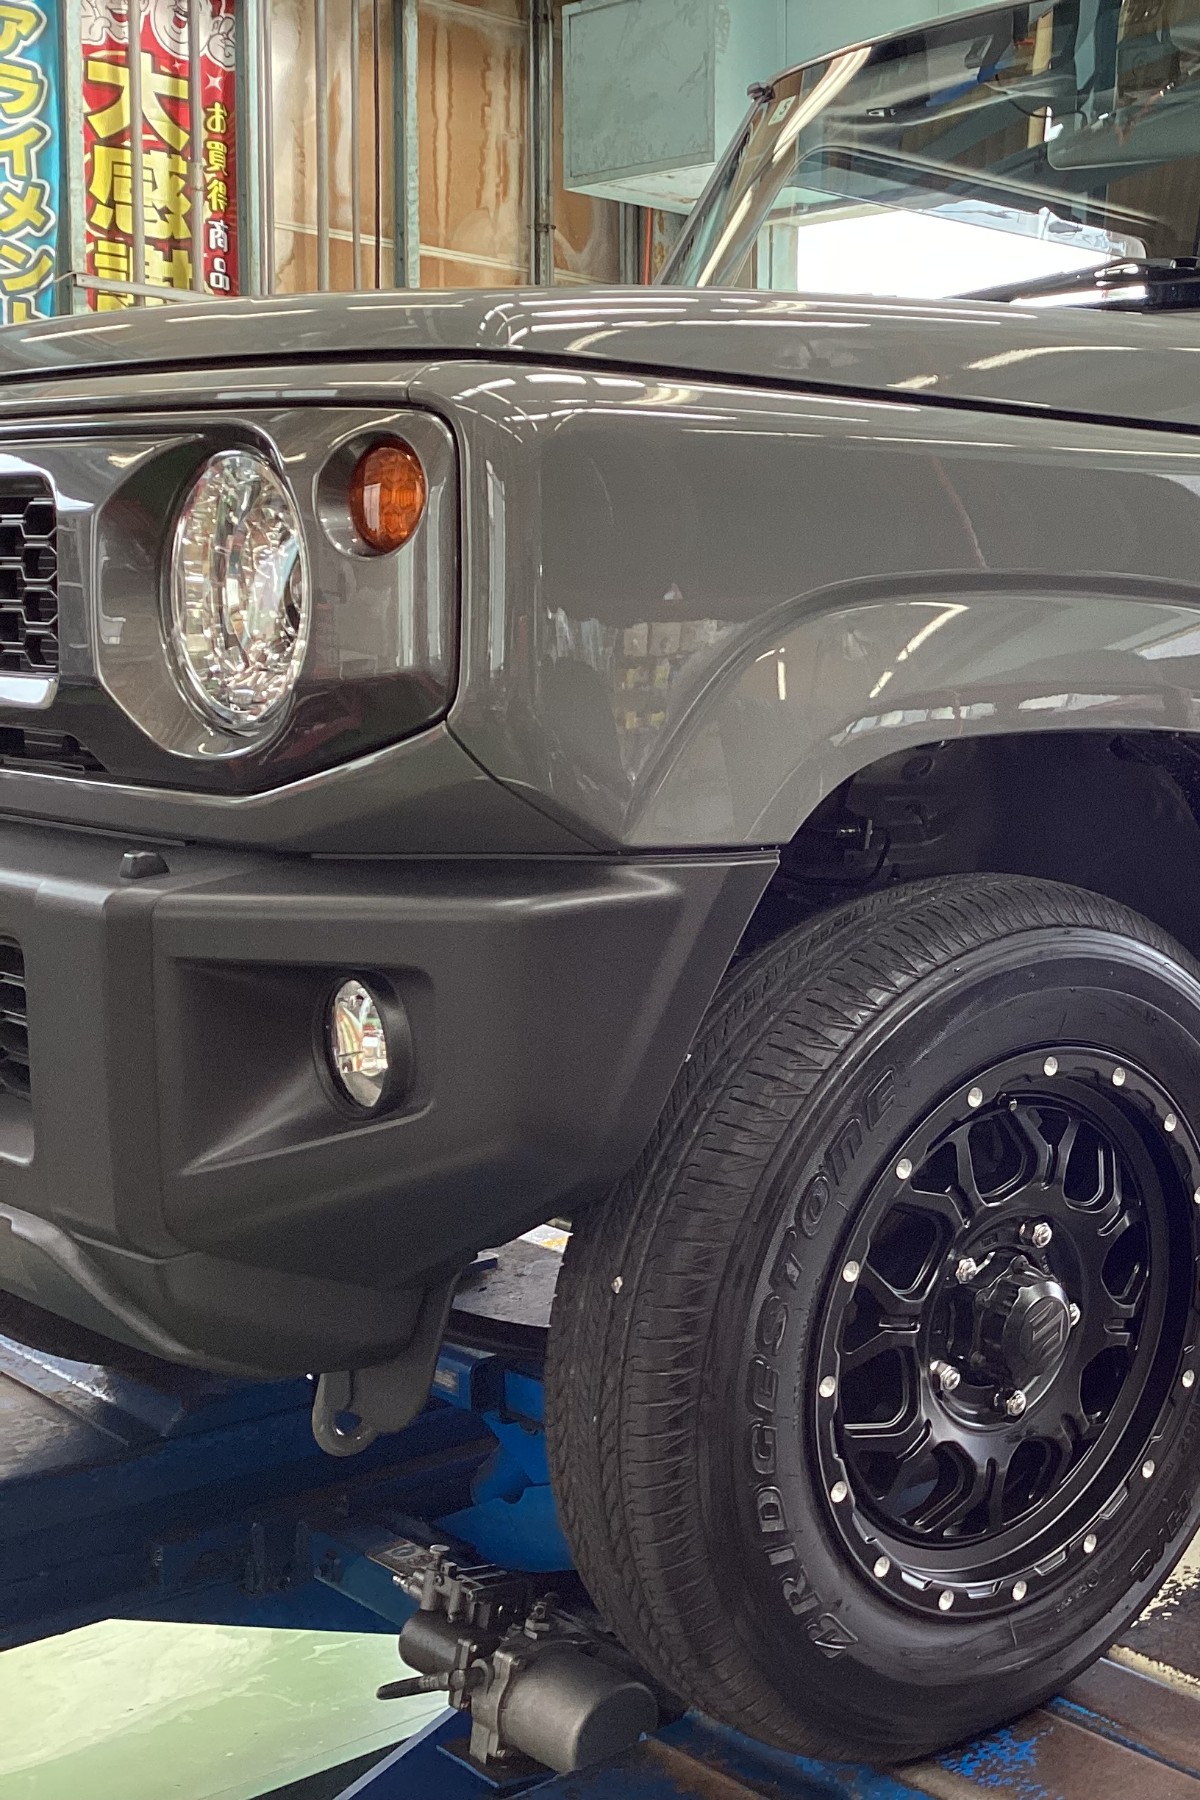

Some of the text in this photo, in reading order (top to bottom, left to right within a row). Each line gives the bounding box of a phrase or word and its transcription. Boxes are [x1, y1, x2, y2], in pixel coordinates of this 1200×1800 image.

[0, 0, 54, 324] アライメン
[205, 101, 230, 291] お買得商品
[746, 1067, 897, 1659] BRIDGESTONE
